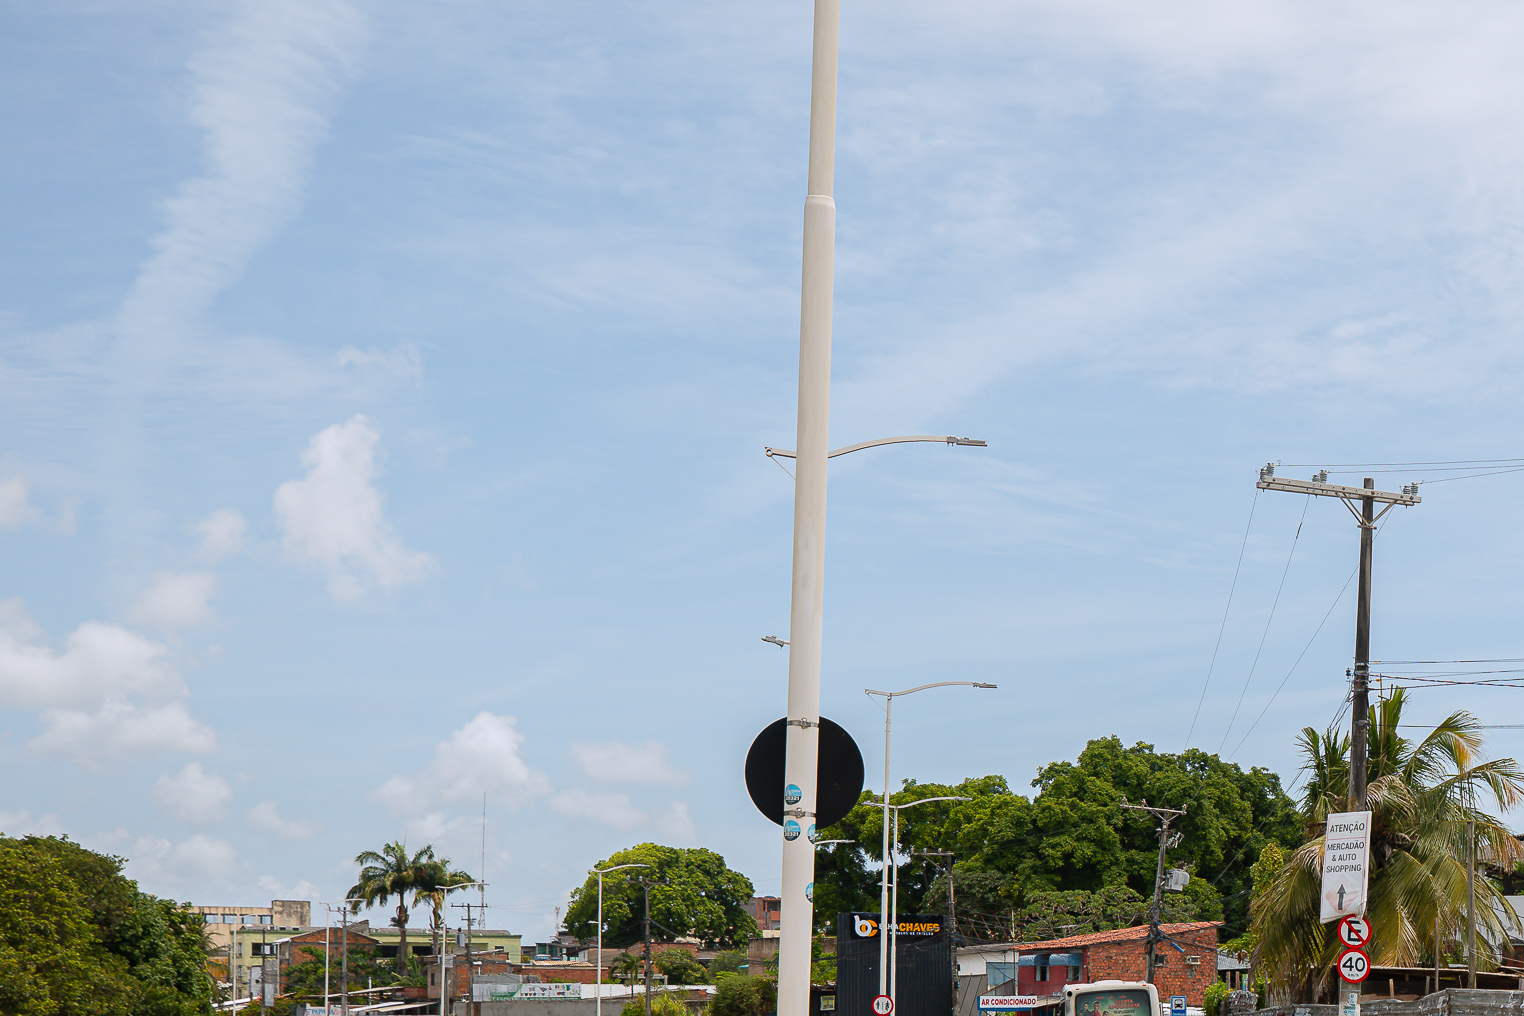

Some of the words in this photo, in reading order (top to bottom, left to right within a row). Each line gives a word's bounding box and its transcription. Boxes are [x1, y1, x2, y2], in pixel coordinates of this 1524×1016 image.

[1330, 821, 1365, 833] ATENÇÃO
[1327, 840, 1365, 851] MERCADÃO
[1338, 853, 1357, 861] AUTO
[1326, 864, 1362, 873] SHOPPING
[1342, 956, 1366, 972] 40
[981, 998, 990, 1006] AR
[990, 998, 1036, 1006] CONDICIONADO
